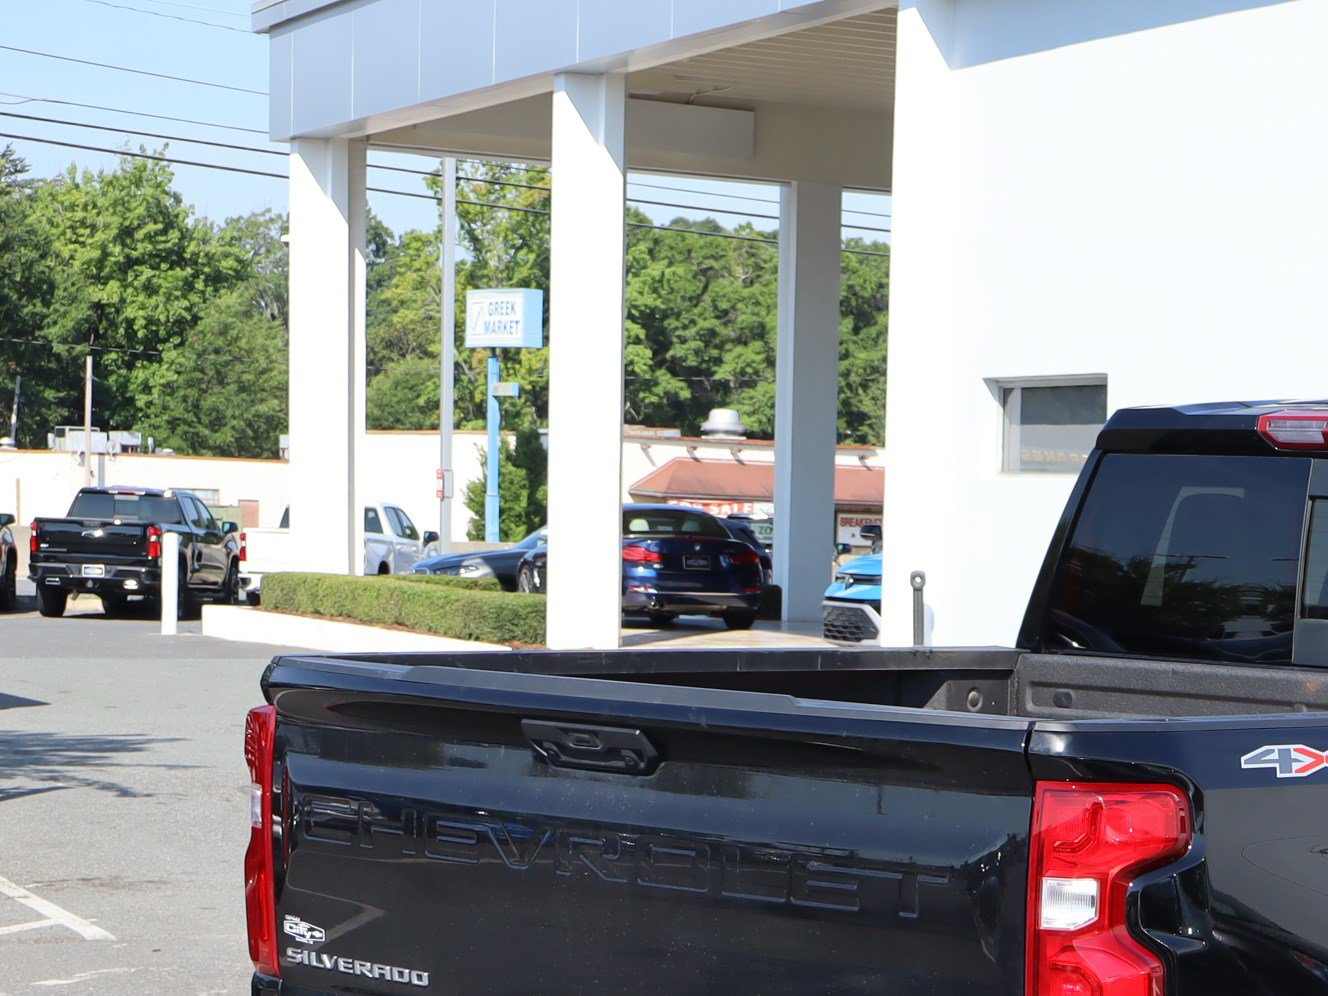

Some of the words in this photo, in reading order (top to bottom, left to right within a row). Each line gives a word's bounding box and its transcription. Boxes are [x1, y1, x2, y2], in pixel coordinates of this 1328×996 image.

[488, 301, 516, 316] GREEK
[484, 320, 520, 335] MARKET
[709, 503, 753, 516] SALE
[302, 794, 952, 918] CHEVROLET
[286, 947, 430, 987] SILVERADO
